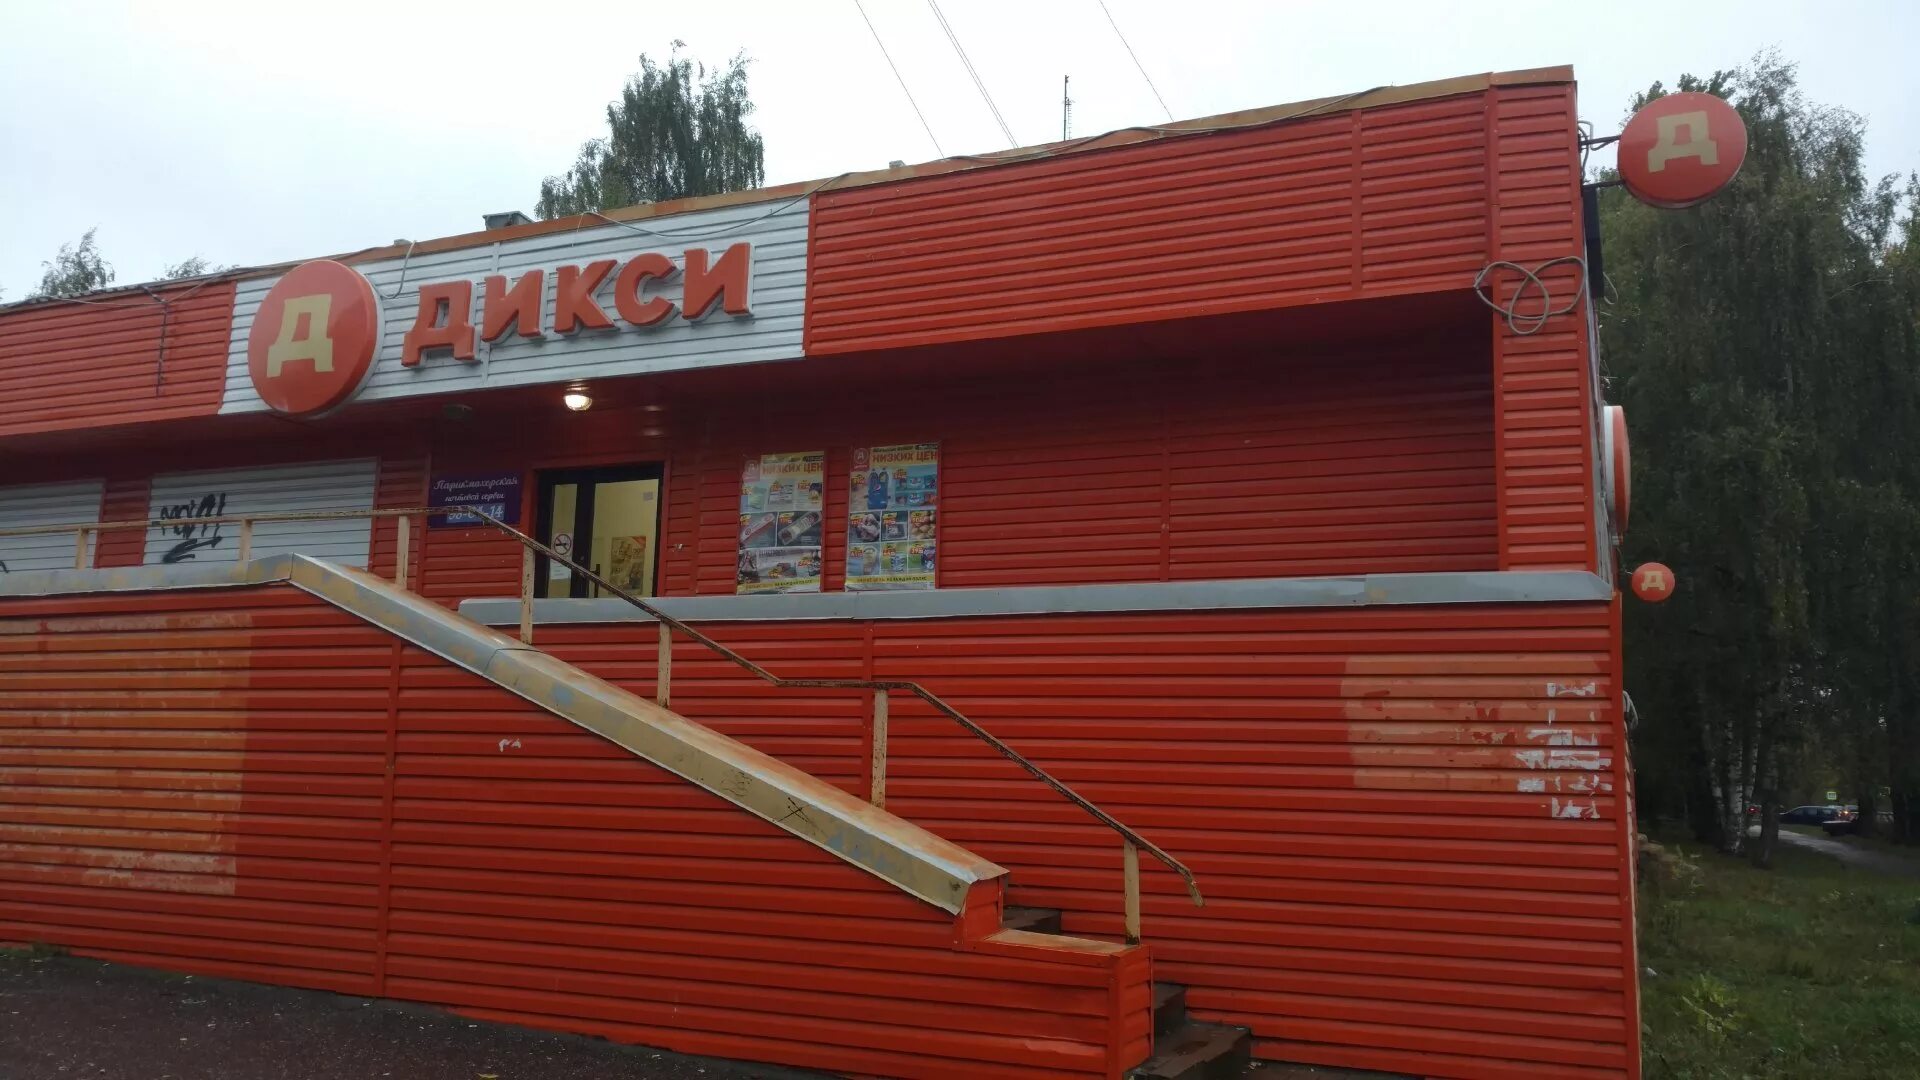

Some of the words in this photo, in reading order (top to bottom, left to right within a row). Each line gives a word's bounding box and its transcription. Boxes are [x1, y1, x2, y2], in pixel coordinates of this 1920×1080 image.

[1648, 111, 1719, 172] Д
[401, 243, 755, 367] ДИКСИ
[267, 294, 334, 377] Д
[872, 451, 914, 463] НИЗКИХ
[916, 450, 938, 462] ЦЕН
[762, 463, 802, 475] НИЗКИХ
[803, 462, 824, 474] ЦЕН
[434, 478, 518, 491] Парикмахерская
[1641, 570, 1666, 591] Д
